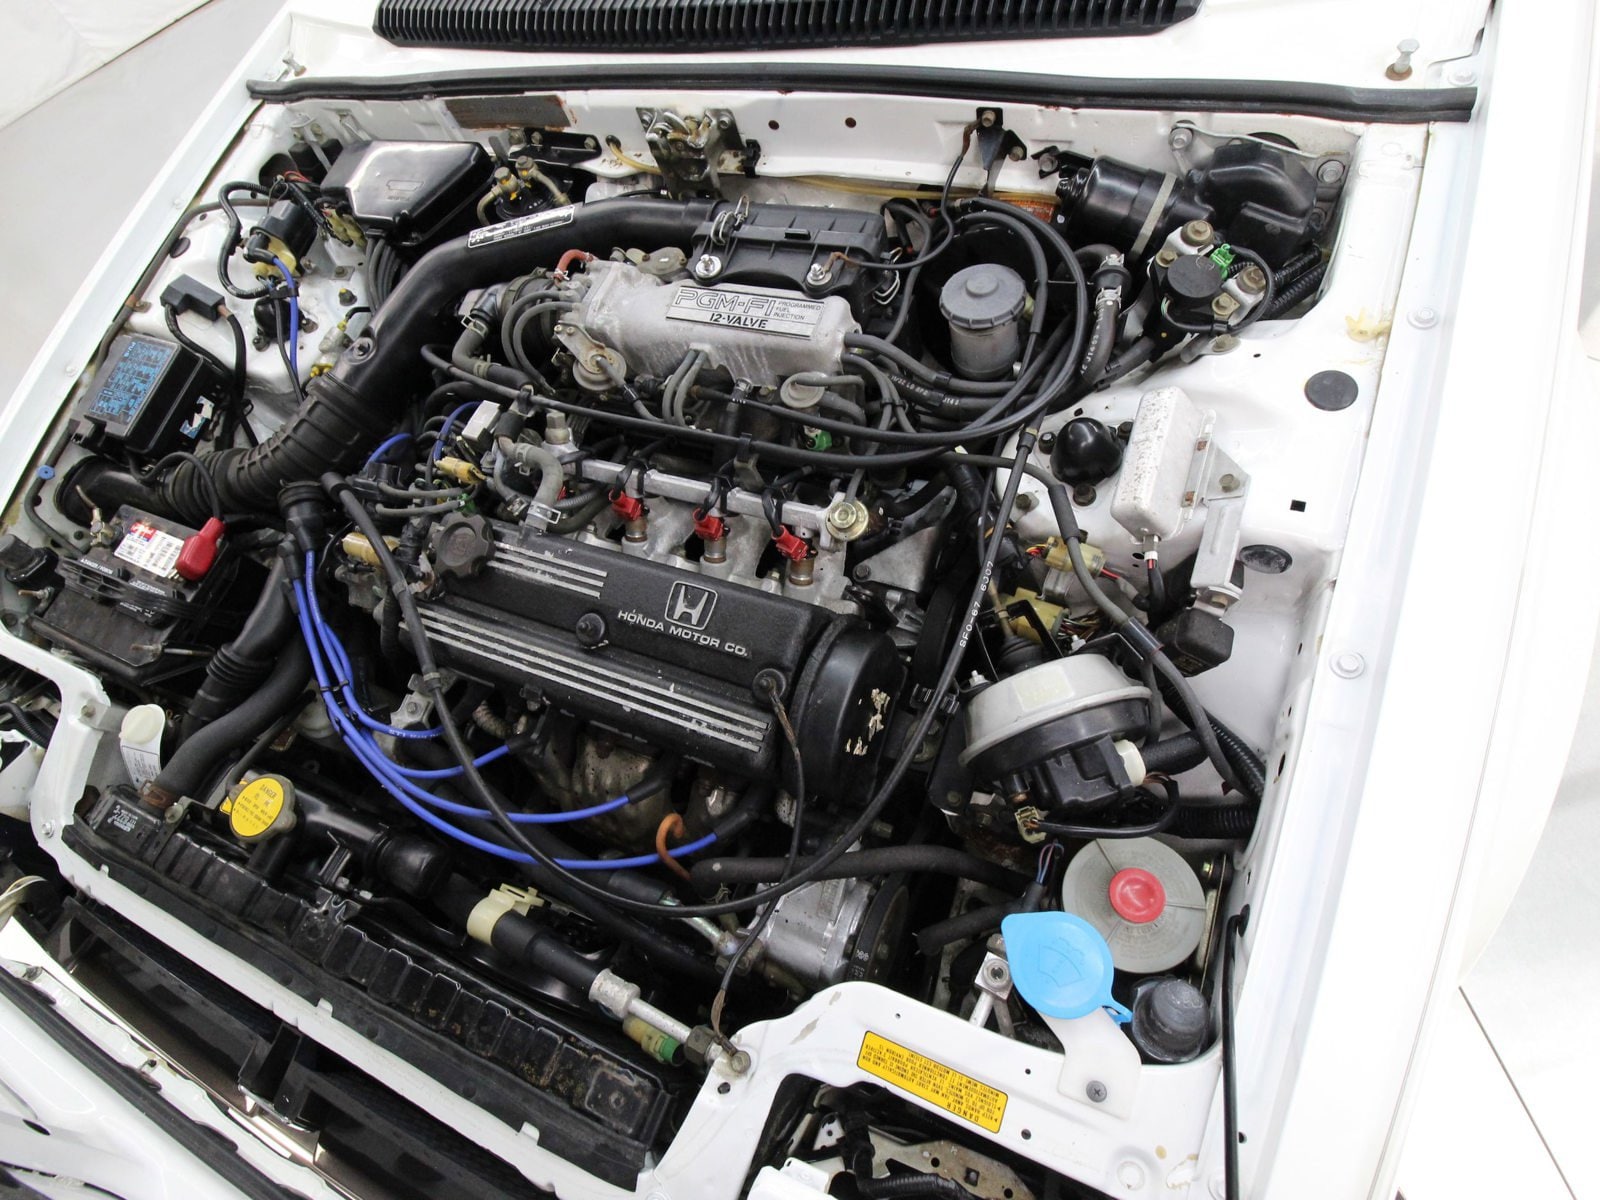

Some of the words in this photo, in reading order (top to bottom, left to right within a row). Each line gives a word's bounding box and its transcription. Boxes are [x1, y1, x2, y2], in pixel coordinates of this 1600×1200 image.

[675, 289, 777, 316] PGM-FI
[777, 301, 821, 311] PROGRAMMED
[709, 312, 769, 329] 12-VALVE
[773, 311, 806, 321] INJECTION
[617, 609, 665, 632] HONDA
[669, 625, 721, 649] MOTOR
[946, 1101, 979, 1122] DANGER
